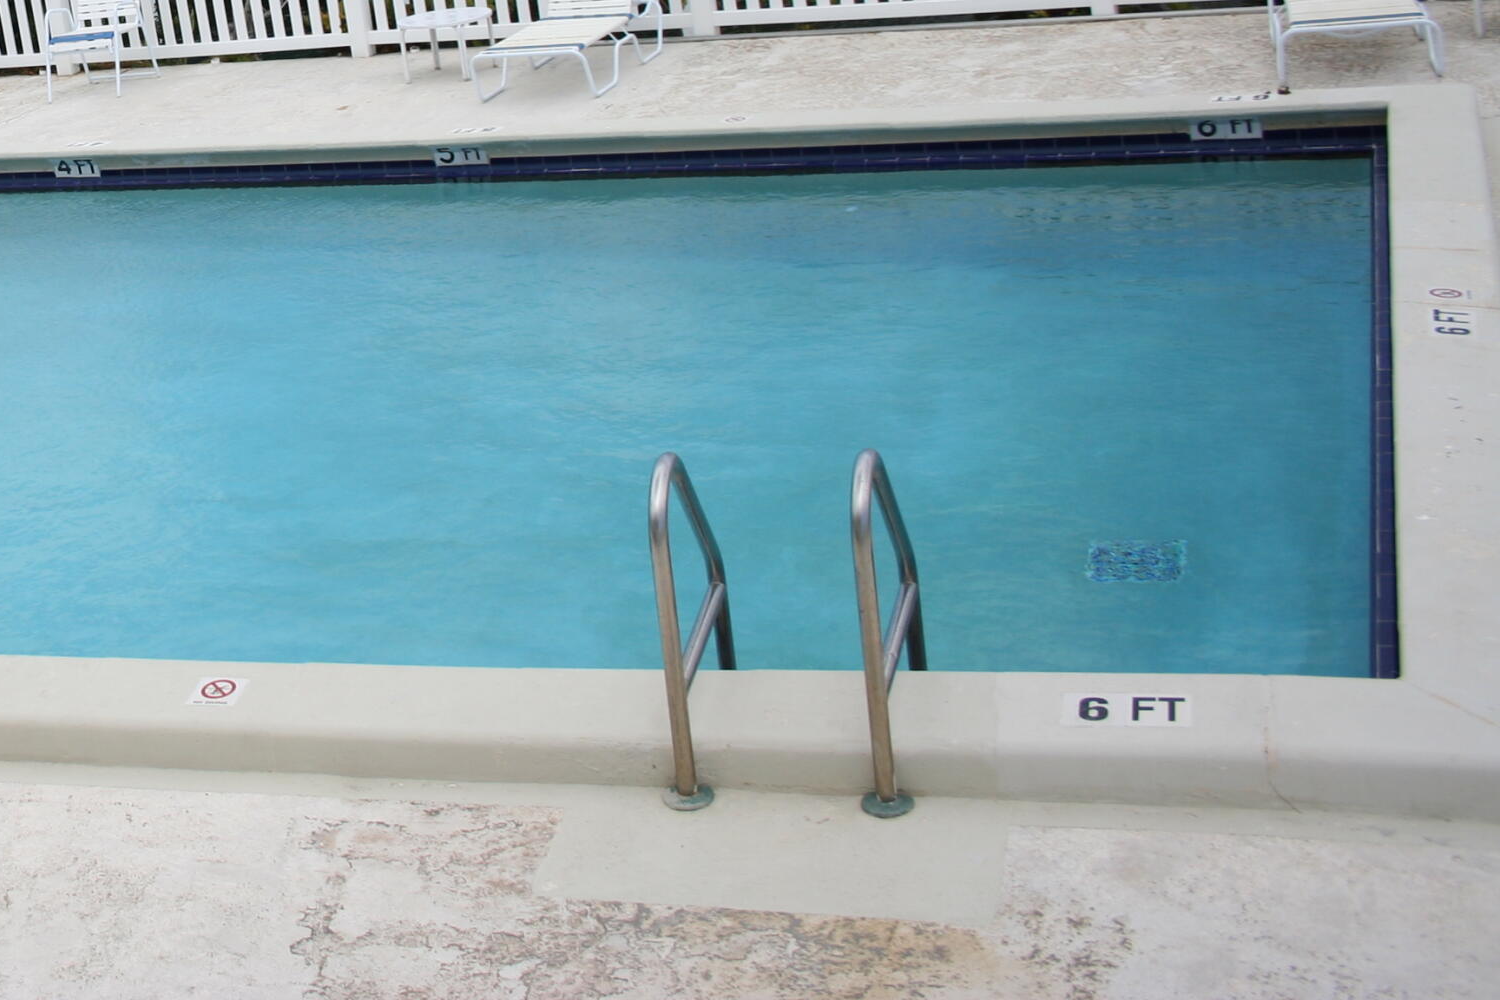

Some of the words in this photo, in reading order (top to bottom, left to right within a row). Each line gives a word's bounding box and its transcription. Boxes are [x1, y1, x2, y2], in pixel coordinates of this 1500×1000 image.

[1197, 120, 1217, 137] 6
[1229, 118, 1253, 134] FT
[436, 147, 455, 164] 5
[461, 147, 481, 161] FT
[58, 159, 71, 174] 4
[73, 159, 95, 175] FT
[1433, 308, 1471, 324] FT
[1434, 326, 1471, 335] 6
[1078, 697, 1109, 721] 6
[1132, 697, 1186, 721] FT
